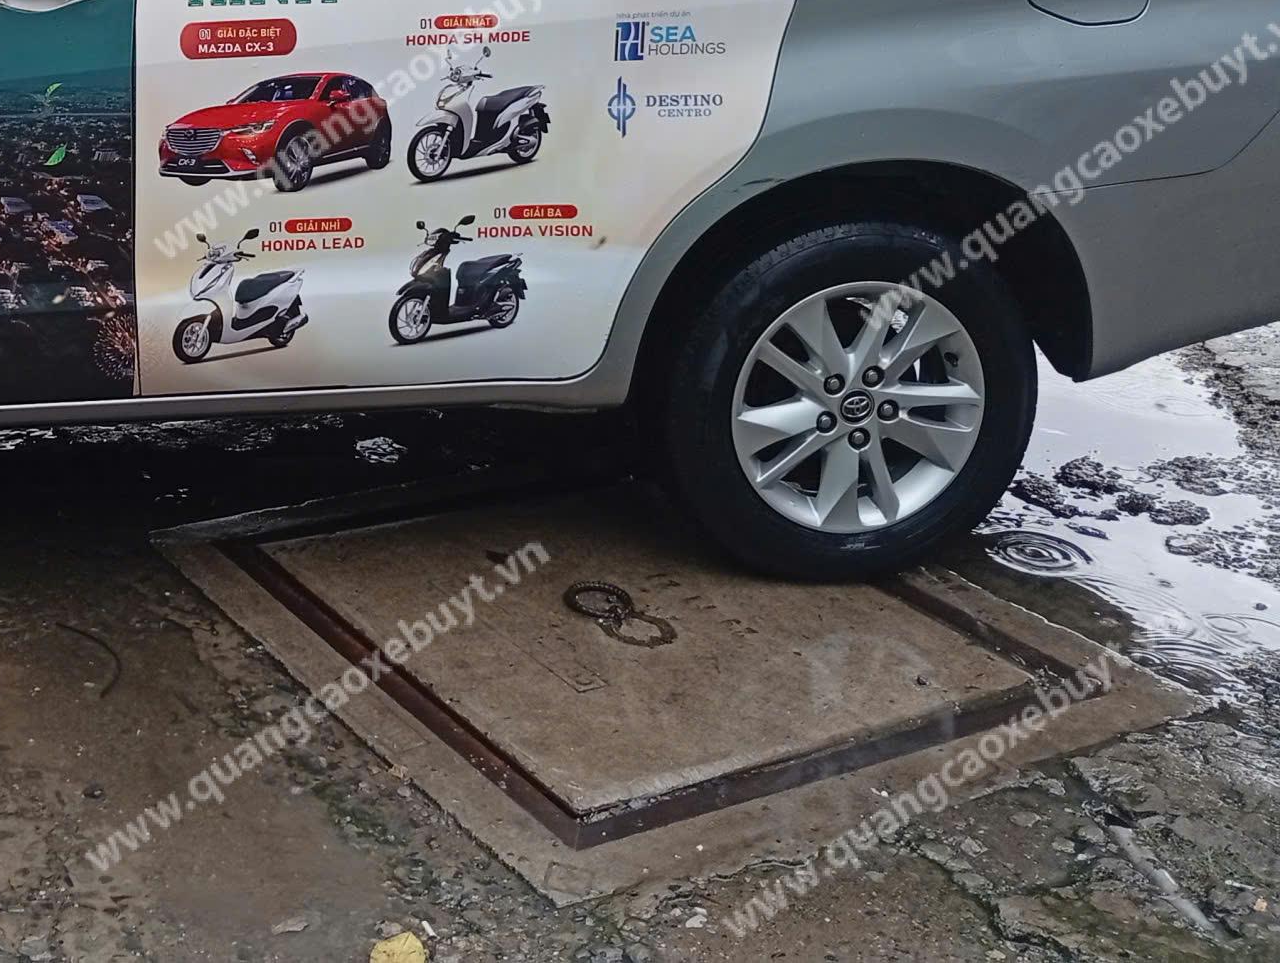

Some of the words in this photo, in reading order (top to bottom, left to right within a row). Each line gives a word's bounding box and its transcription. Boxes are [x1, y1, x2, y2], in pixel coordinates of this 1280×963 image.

[420, 18, 432, 30] 01
[218, 27, 236, 38] GIẢI
[260, 26, 281, 40] BIỆT
[406, 33, 458, 46] HONDA
[463, 33, 483, 45] SH
[488, 31, 530, 44] MODE
[649, 25, 696, 43] SEA
[198, 43, 242, 54] MAZDA
[245, 41, 274, 52] CX-3
[648, 42, 726, 56] HOLDINGS
[646, 94, 723, 107] DESTINO
[657, 108, 712, 117] CENTRO
[494, 208, 507, 219] 01
[523, 207, 545, 218] GIẢI
[547, 208, 562, 218] BA
[269, 222, 282, 233] 01
[296, 220, 318, 232] GIẢI
[478, 225, 532, 238] HONDA
[538, 224, 593, 237] VISION
[261, 239, 317, 253] HONDA
[322, 237, 365, 251] LEAD
